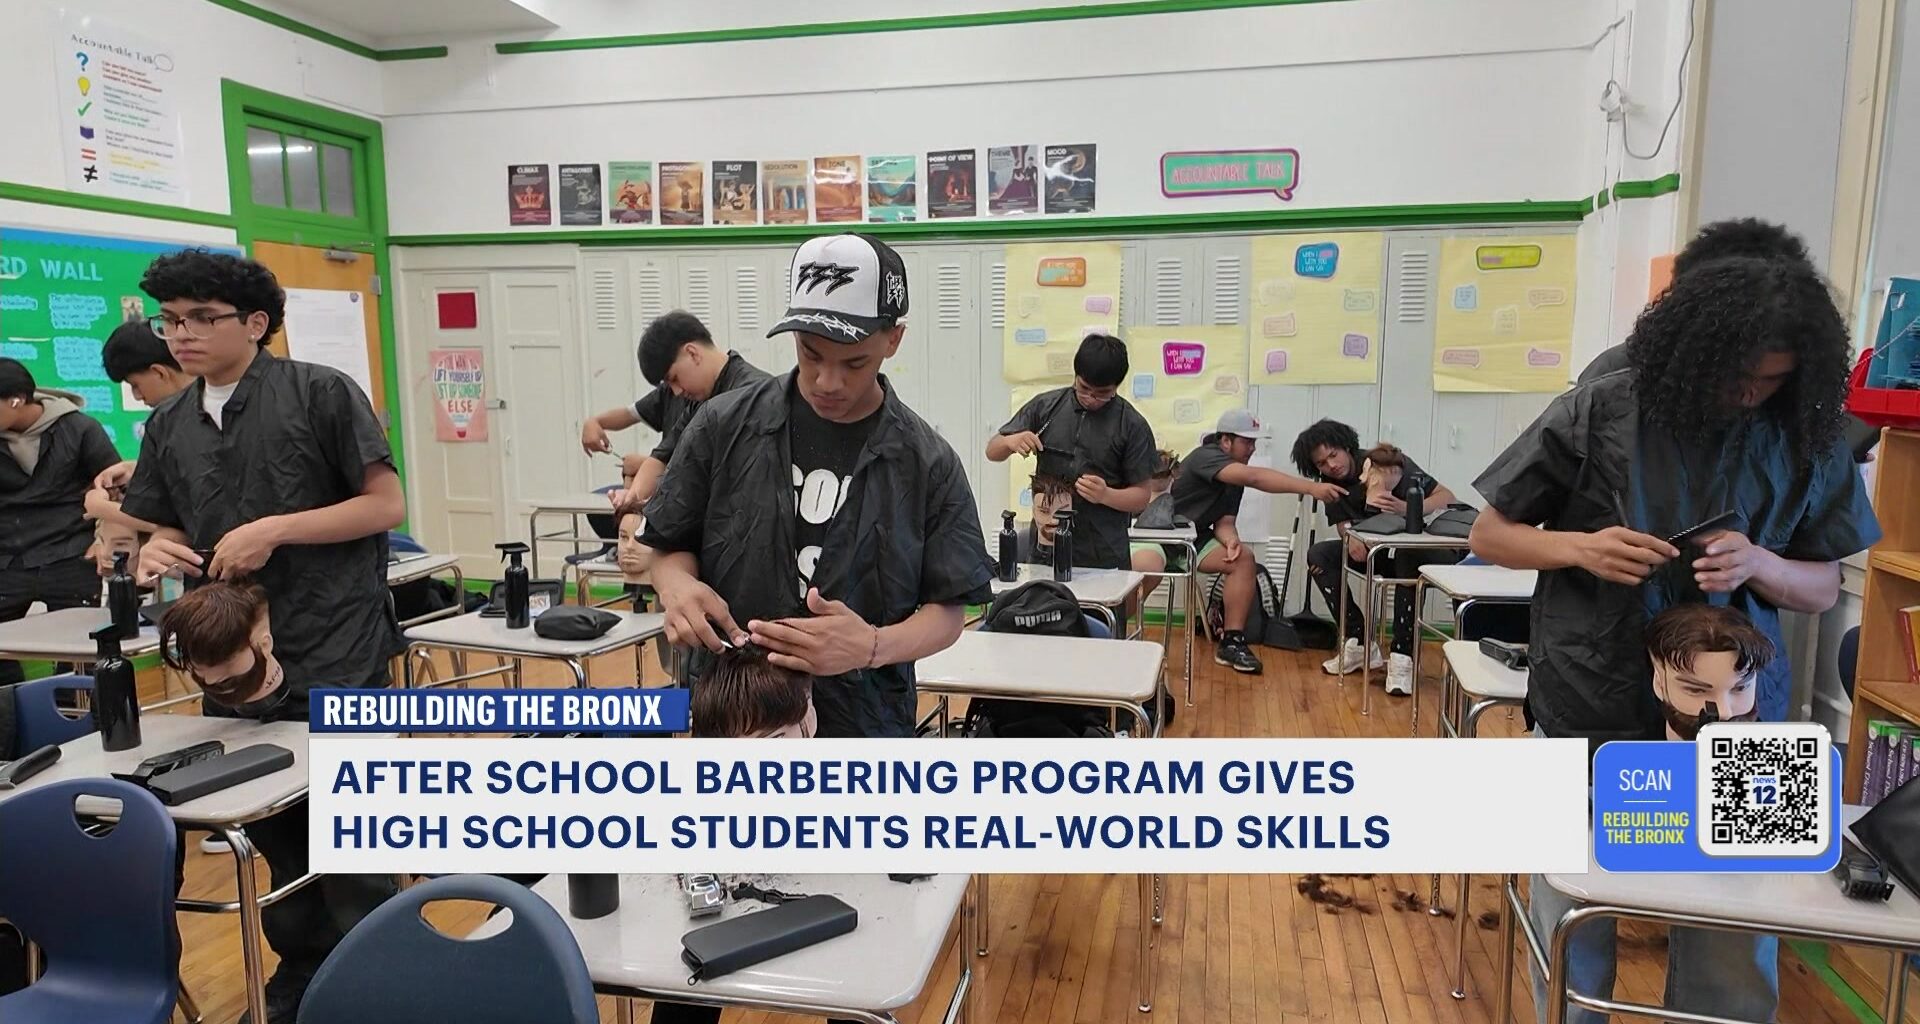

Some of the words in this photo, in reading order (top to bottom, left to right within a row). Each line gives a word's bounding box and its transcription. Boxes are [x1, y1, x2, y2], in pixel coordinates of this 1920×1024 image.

[71, 33, 132, 58] Accountable
[1047, 148, 1067, 156] MOOD
[928, 155, 947, 163] POINT
[947, 154, 957, 162] OF
[516, 166, 539, 174] CLIMAX
[725, 164, 742, 172] PLOT
[1173, 162, 1249, 185] ACCOUNTABLE
[1255, 159, 1285, 179] TALK
[39, 258, 103, 281] WALL
[447, 399, 473, 413] ELSE
